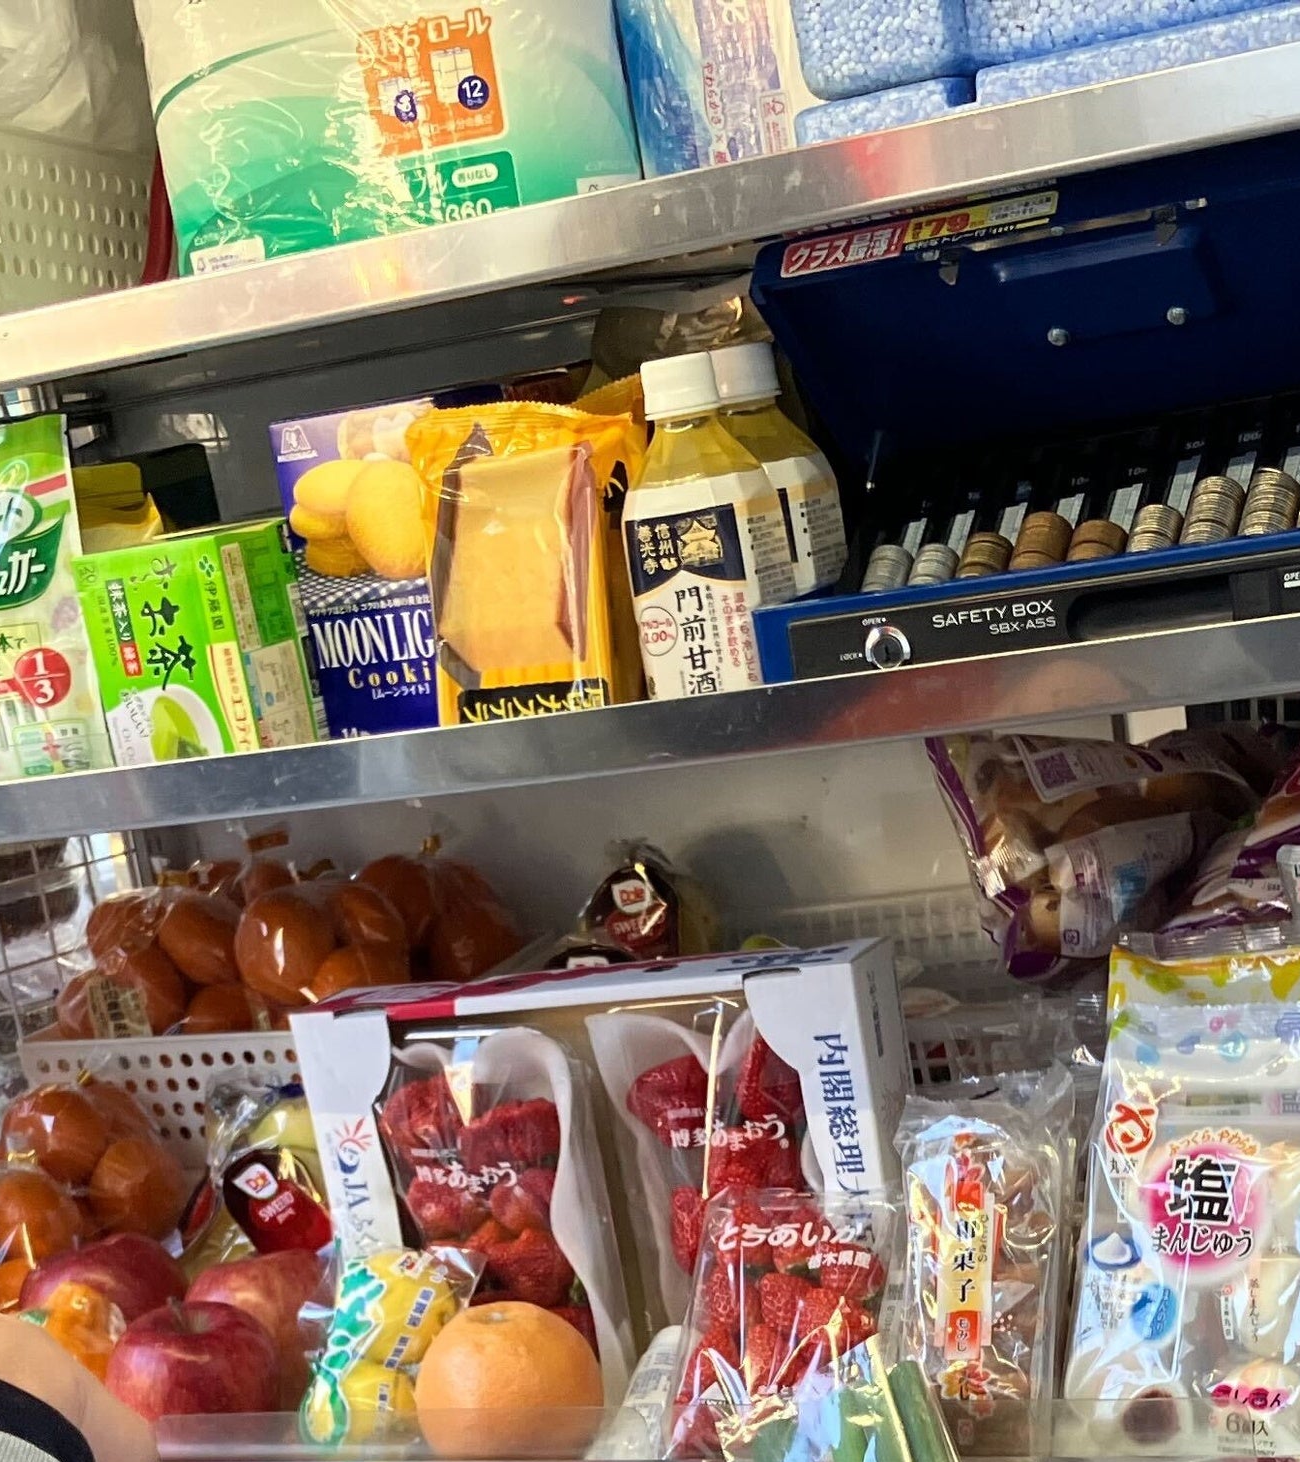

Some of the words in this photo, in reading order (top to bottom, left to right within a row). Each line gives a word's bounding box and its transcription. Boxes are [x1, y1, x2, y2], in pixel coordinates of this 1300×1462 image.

[461, 79, 483, 98] 12
[638, 524, 660, 575] 善光寺
[932, 606, 1007, 629] SAFETY
[1012, 600, 1055, 618] BOX
[989, 616, 1057, 635] SBX-A5S
[311, 609, 436, 669] MOONLIG
[674, 585, 718, 695] 門前甘酒
[348, 661, 432, 689] Cooki
[1169, 1156, 1241, 1224] 塩
[718, 1222, 864, 1252] とちあいか
[1151, 1225, 1254, 1258] まんじゅう
